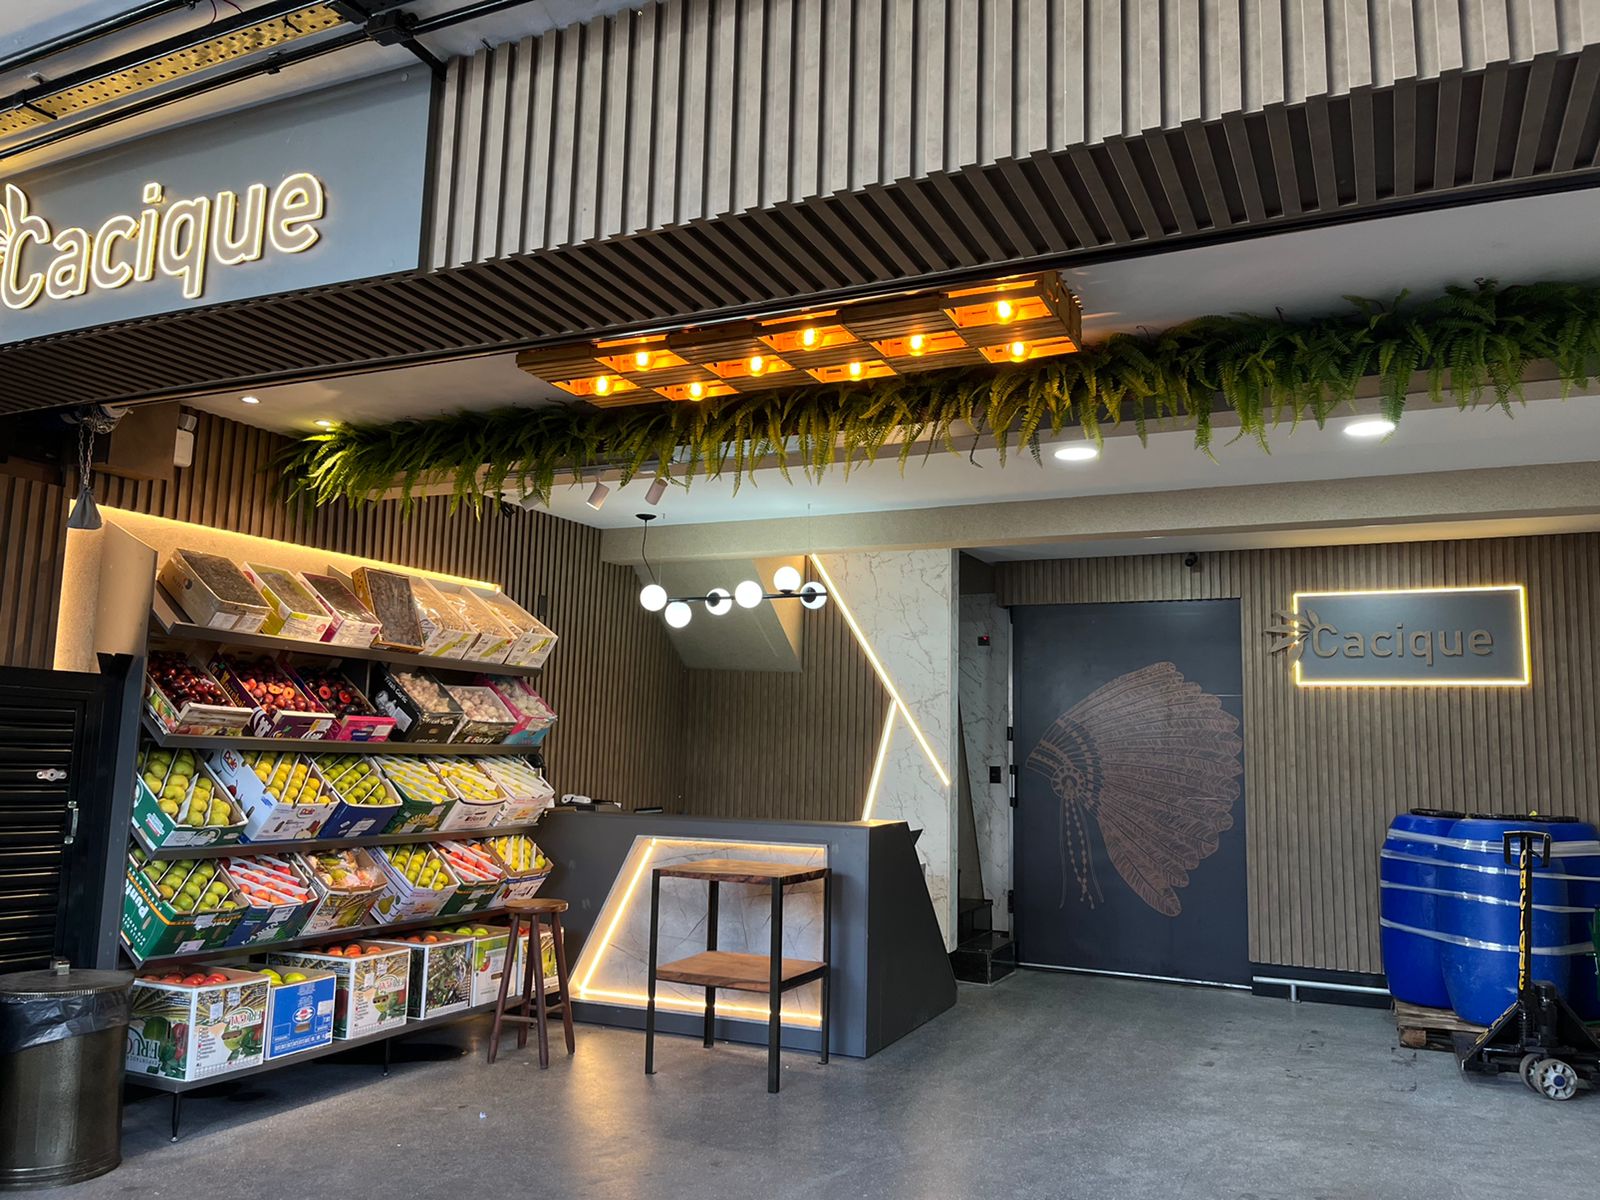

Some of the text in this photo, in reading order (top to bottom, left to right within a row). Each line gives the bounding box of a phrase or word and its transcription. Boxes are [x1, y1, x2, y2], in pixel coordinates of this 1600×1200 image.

[1, 172, 324, 310] Cacique
[1311, 622, 1494, 667] Cacique
[222, 750, 238, 772] Dole
